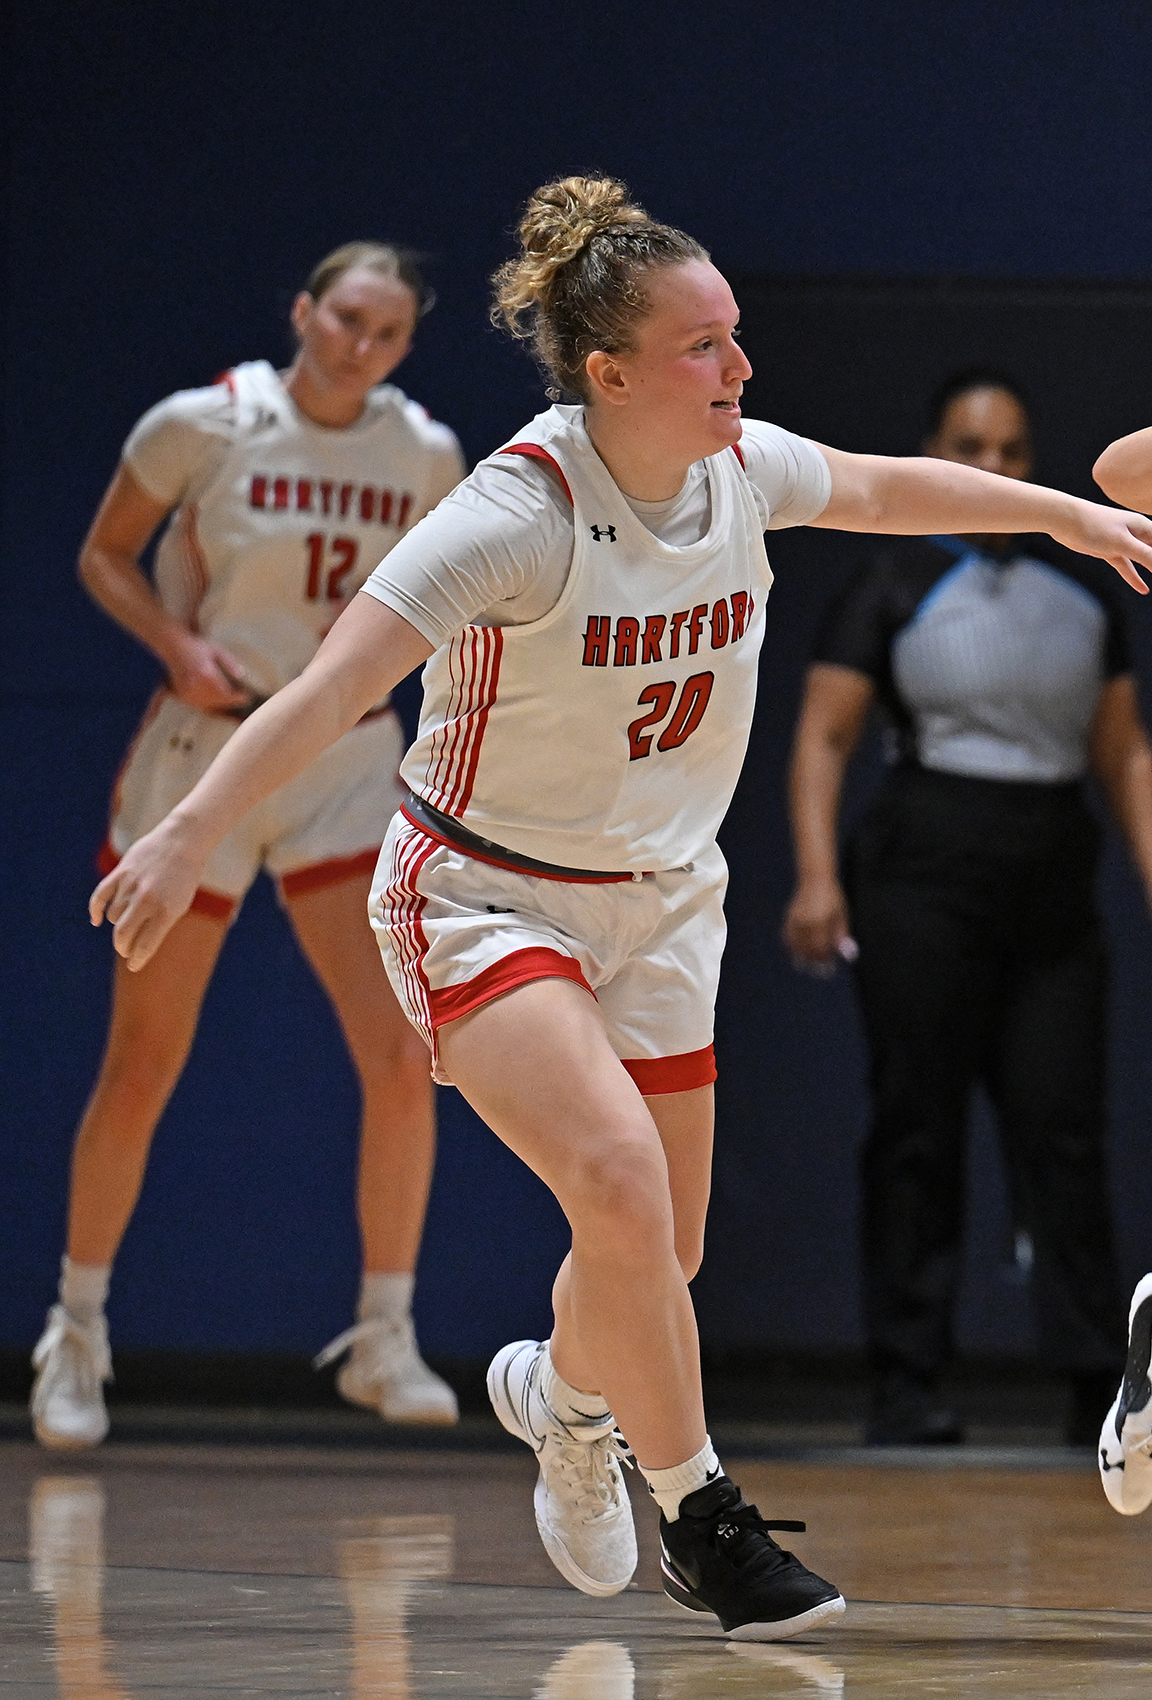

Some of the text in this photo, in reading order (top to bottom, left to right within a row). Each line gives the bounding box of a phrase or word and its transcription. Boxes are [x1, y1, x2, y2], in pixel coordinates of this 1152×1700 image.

[306, 531, 359, 602] 12
[581, 590, 755, 667] HARTFOR
[627, 670, 715, 762] 20
